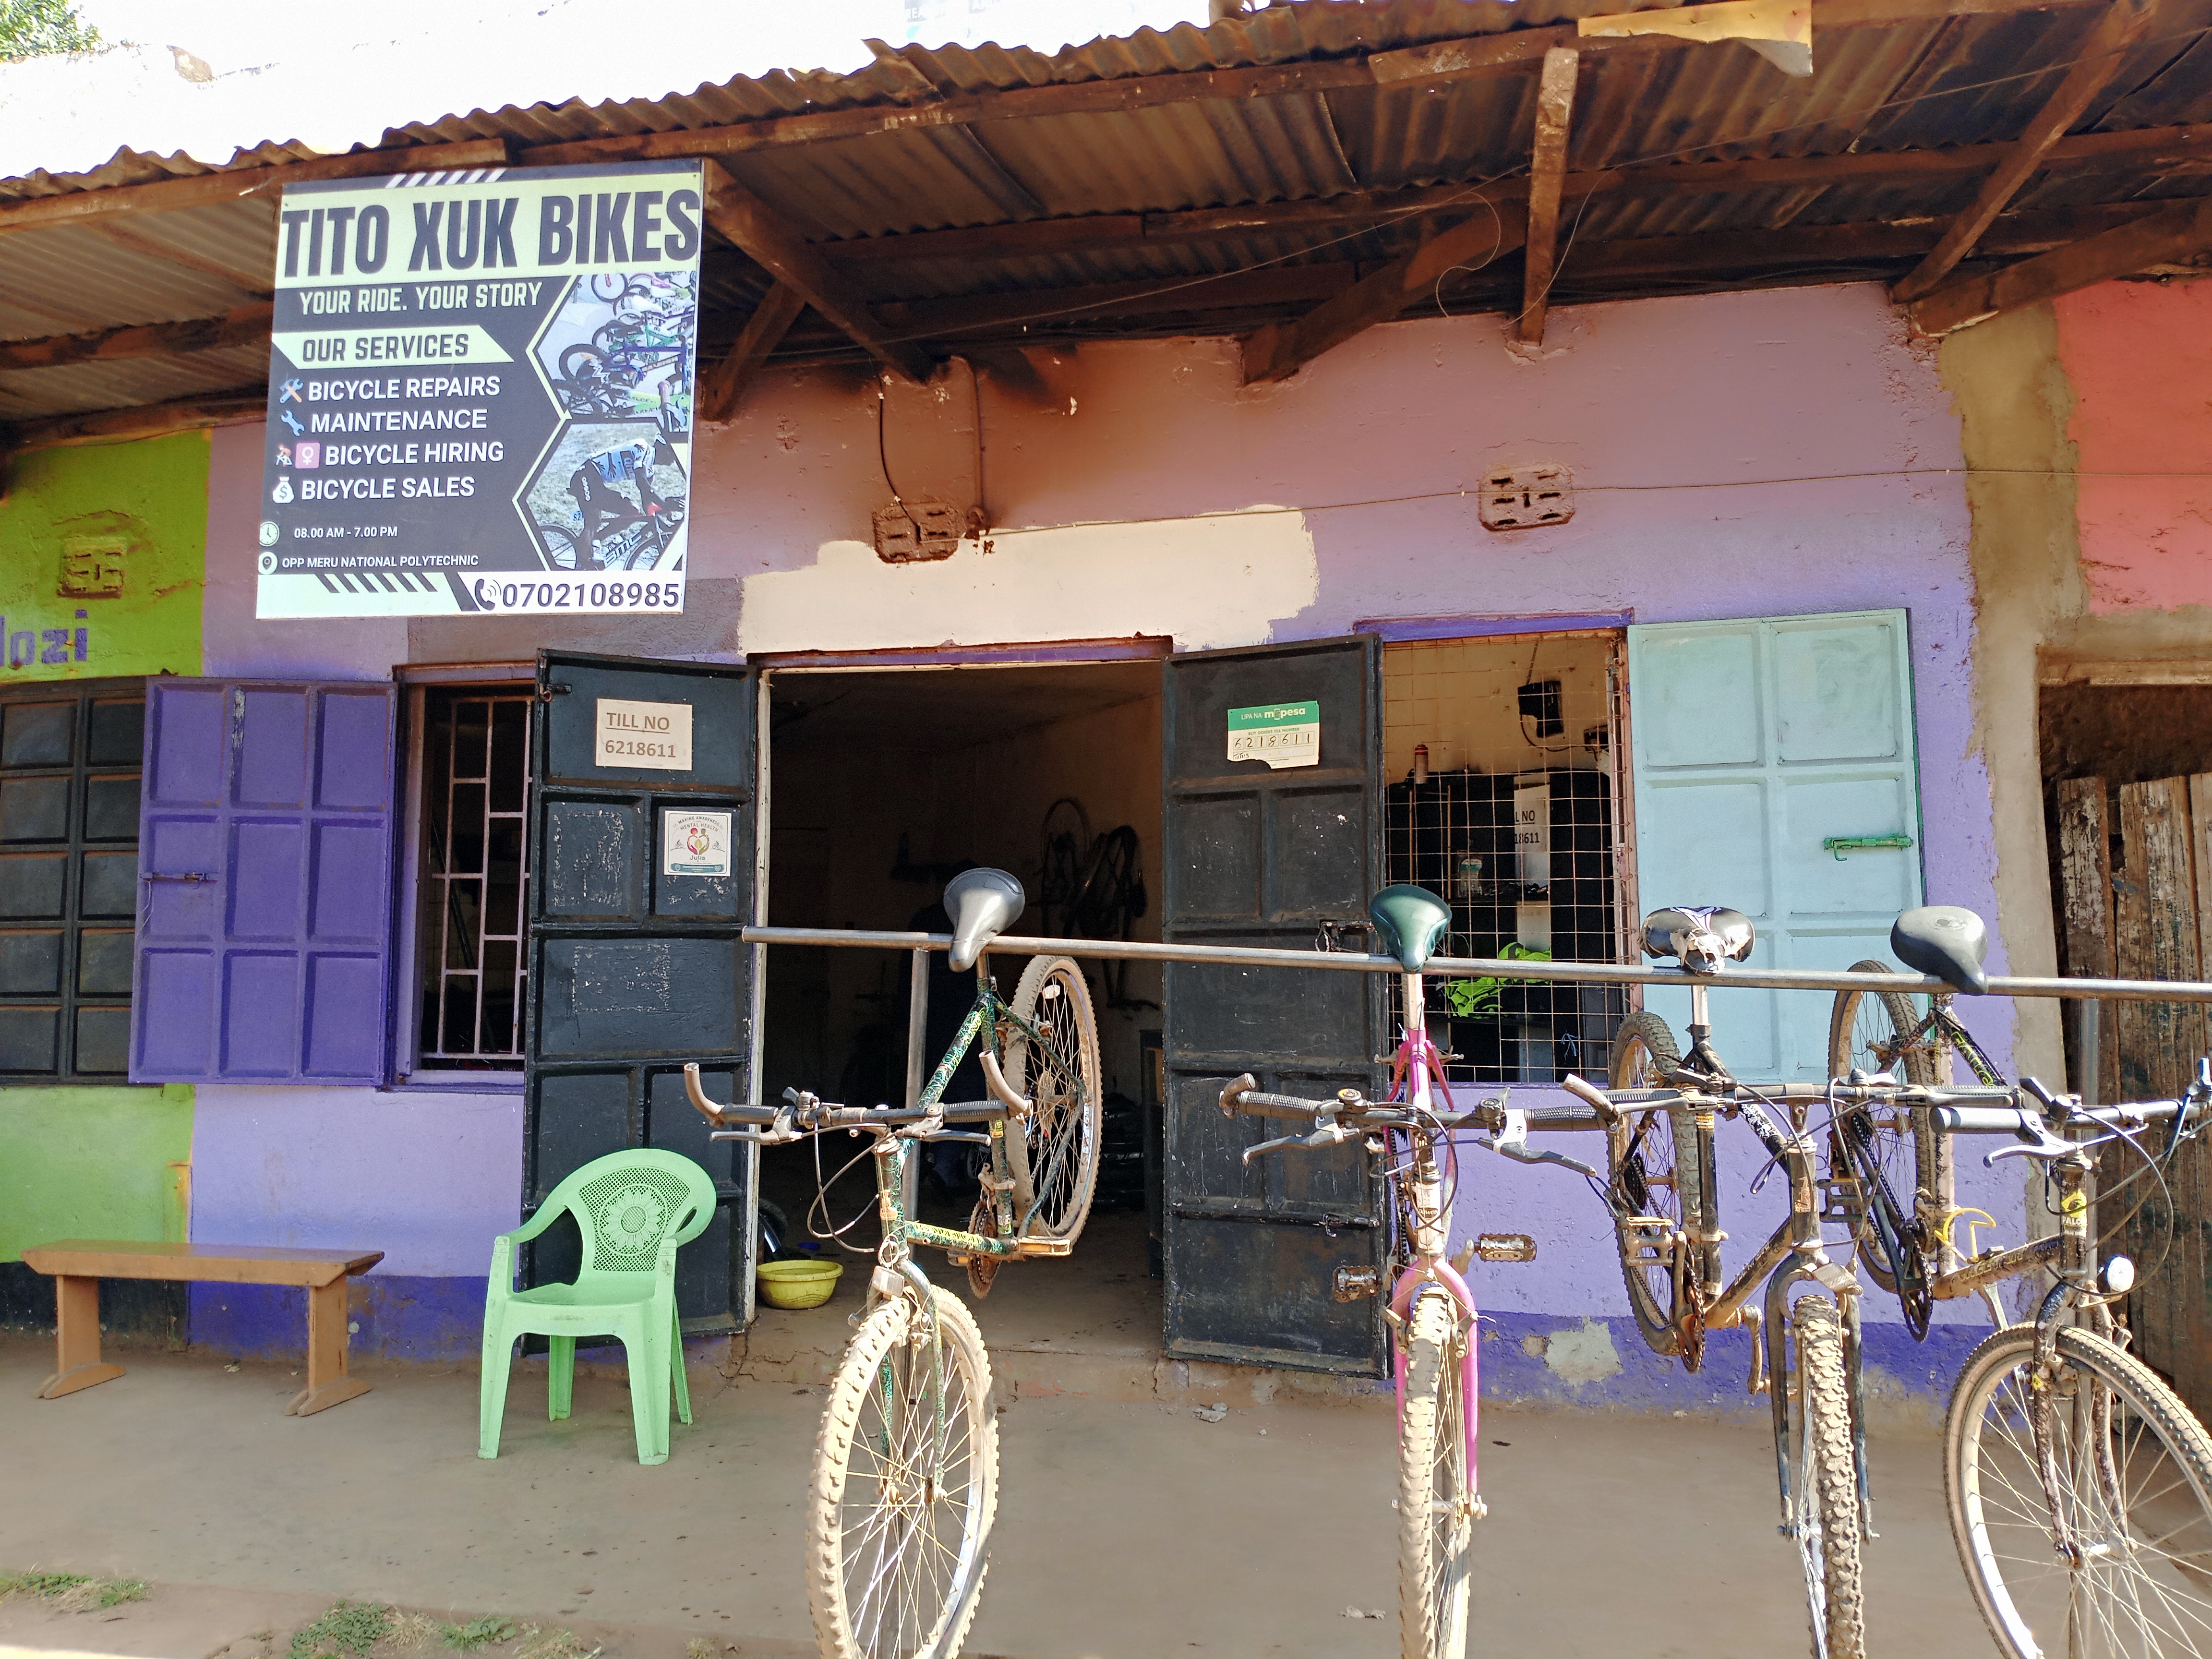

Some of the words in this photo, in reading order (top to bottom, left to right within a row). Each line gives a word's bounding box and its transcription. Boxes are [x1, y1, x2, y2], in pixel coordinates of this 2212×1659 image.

[281, 205, 389, 278] TITO
[408, 197, 520, 272] XUK
[538, 189, 700, 267] BIKES
[300, 289, 349, 315] YOUR
[358, 288, 407, 312] RIDE.
[417, 285, 468, 310] YOUR
[476, 281, 542, 307] STORY
[303, 338, 346, 362] OUR
[355, 334, 469, 361] SERVICES
[308, 380, 400, 401] BICYCLE
[406, 376, 501, 398] REPAIRS
[311, 409, 487, 433] MAINTENANCE
[325, 445, 418, 465] BICYCLE
[424, 442, 504, 462] HIRING
[301, 479, 395, 500] BICYCLE
[402, 477, 475, 497] SALES
[294, 528, 325, 539] 08.00
[326, 527, 344, 538] AM
[354, 527, 377, 537] 7.00
[380, 526, 397, 537] PM
[282, 557, 304, 568] OPP
[307, 556, 337, 567] MERU
[340, 556, 397, 566] NATIONAL
[400, 555, 479, 566] POLYTECHNIC
[502, 582, 679, 608] 0702108985
[606, 712, 638, 728] TILL
[644, 716, 670, 730] NO
[605, 740, 676, 758] 6218611
[696, 817, 720, 826] AWARENESS
[1522, 810, 1535, 821] NO
[701, 824, 719, 832] HEALTH
